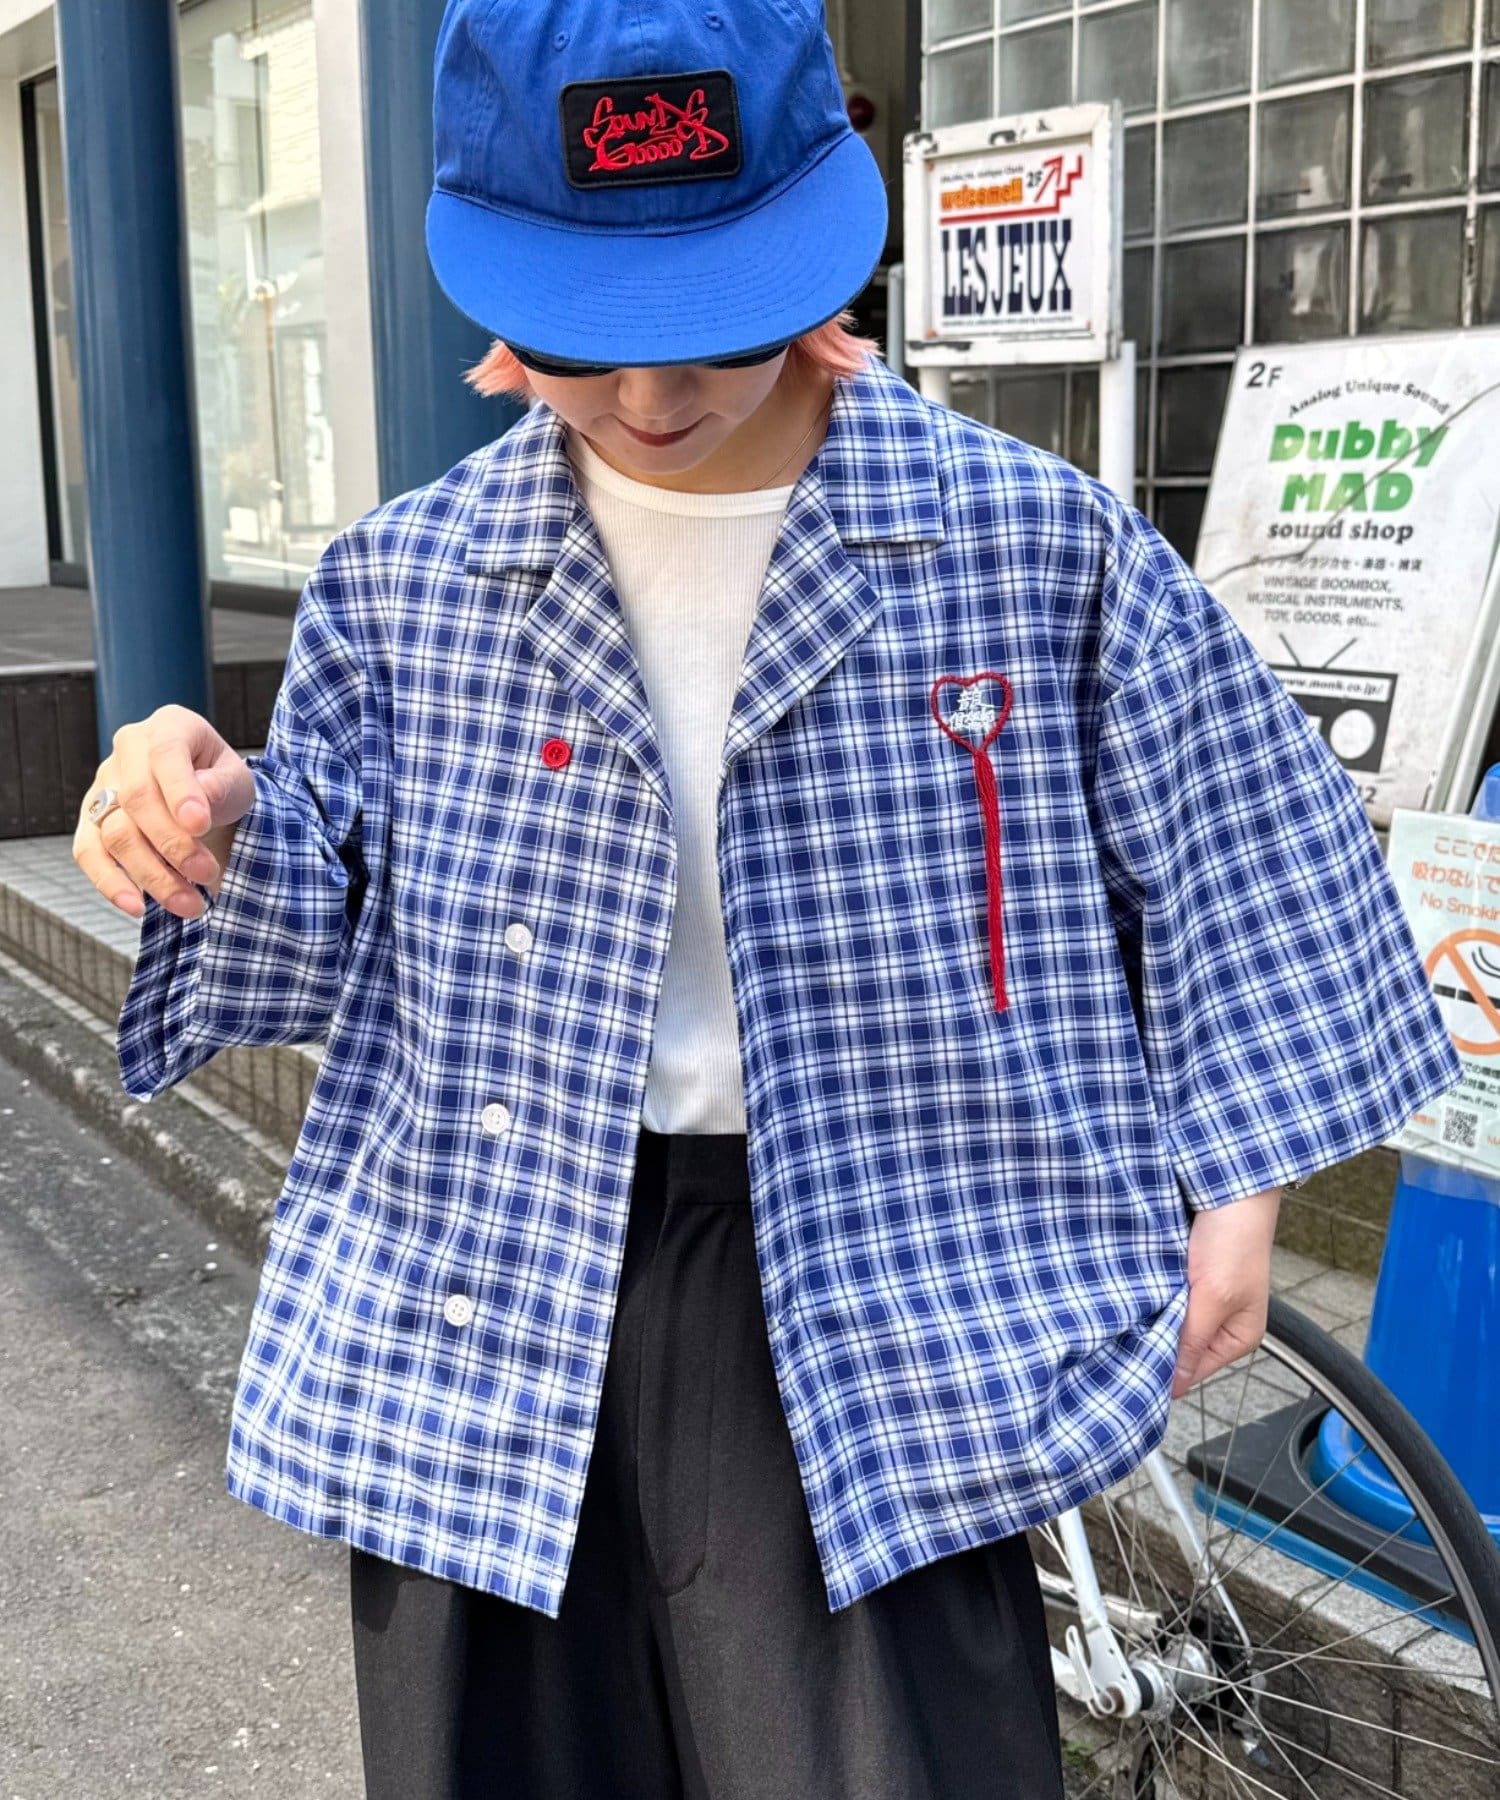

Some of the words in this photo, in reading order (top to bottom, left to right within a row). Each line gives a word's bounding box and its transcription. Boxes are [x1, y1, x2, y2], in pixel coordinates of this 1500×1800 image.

[1245, 361, 1283, 389] 2F
[1288, 386, 1342, 418] Analog
[1345, 379, 1401, 395] Unique
[1402, 382, 1452, 416] Sound
[1267, 418, 1450, 468] Dubby
[1279, 472, 1415, 513] MAD
[1266, 520, 1344, 540] sound
[1349, 518, 1415, 546] shop
[1263, 576, 1318, 590] VINTAGE
[1246, 592, 1301, 606] MUSICAL
[1420, 891, 1443, 910] No
